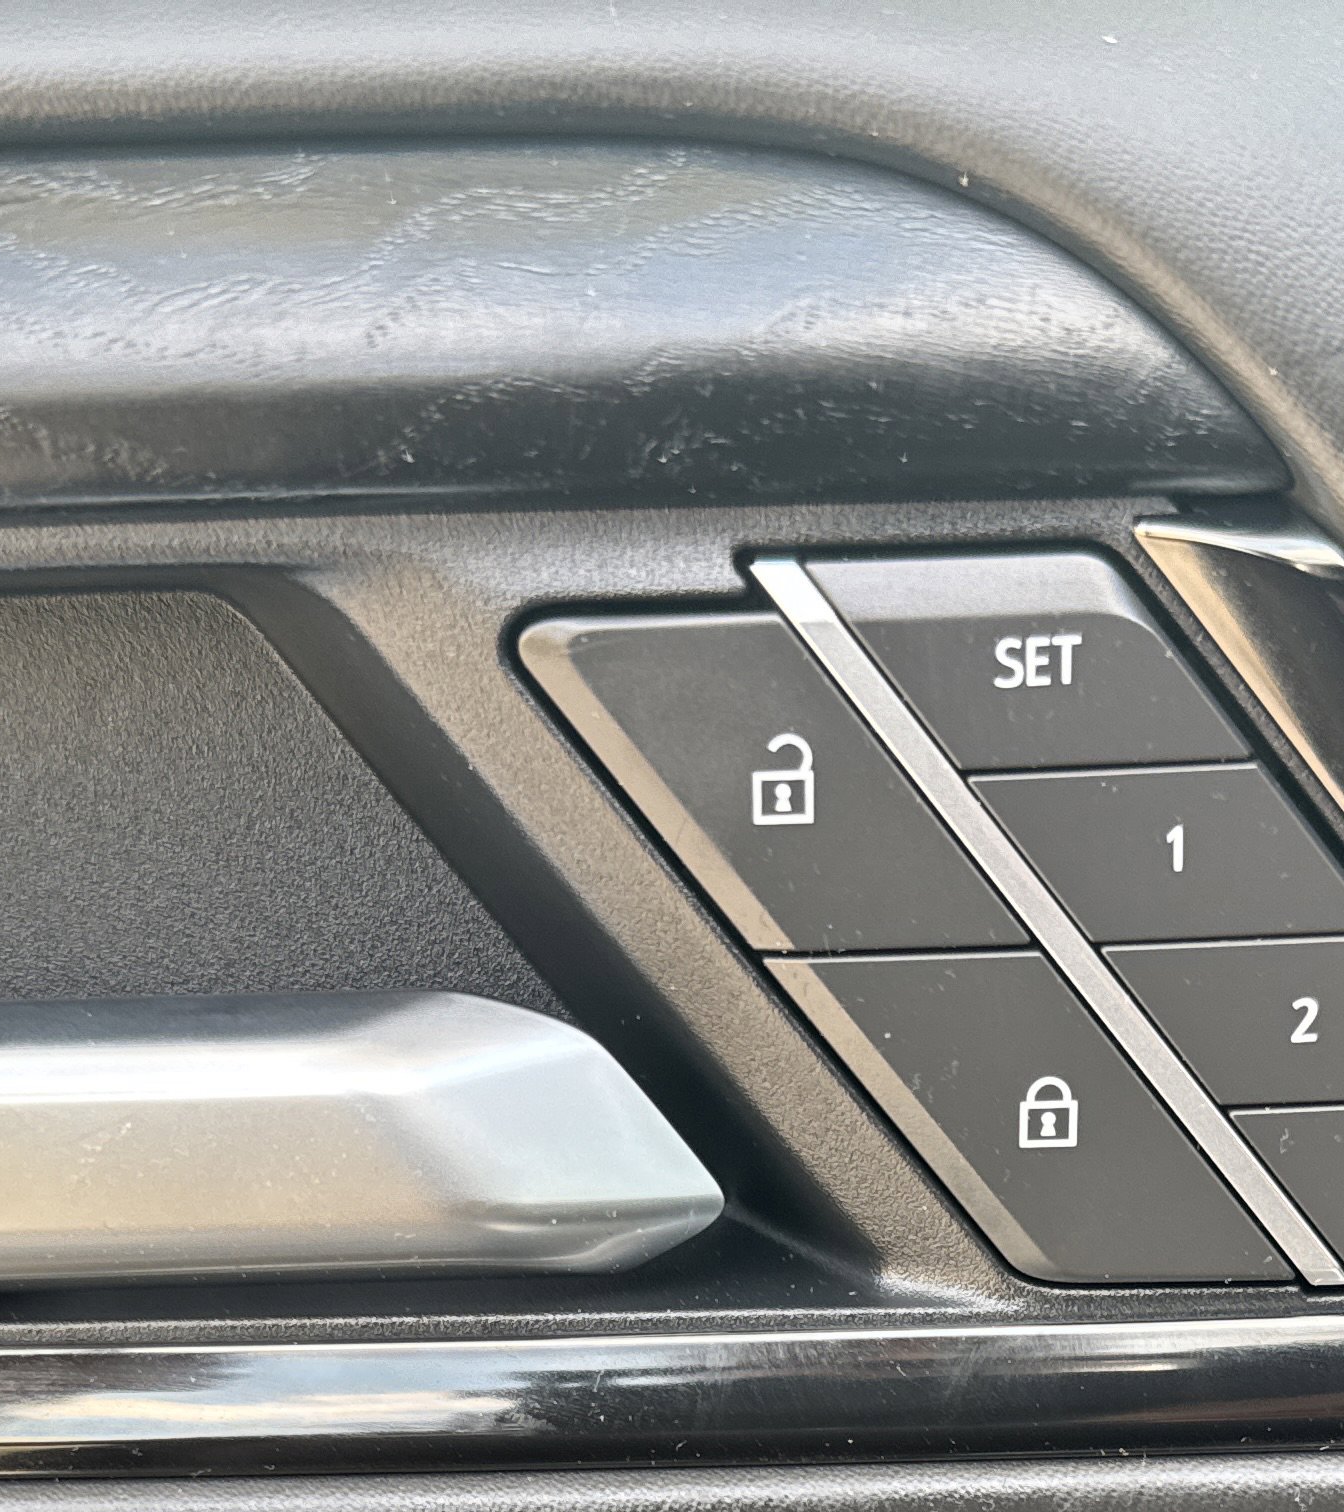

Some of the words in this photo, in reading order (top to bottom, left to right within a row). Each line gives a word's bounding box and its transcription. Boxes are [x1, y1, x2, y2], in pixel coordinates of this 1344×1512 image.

[993, 633, 1083, 689] SET
[1165, 823, 1184, 873] 1
[1290, 995, 1320, 1044] 2
